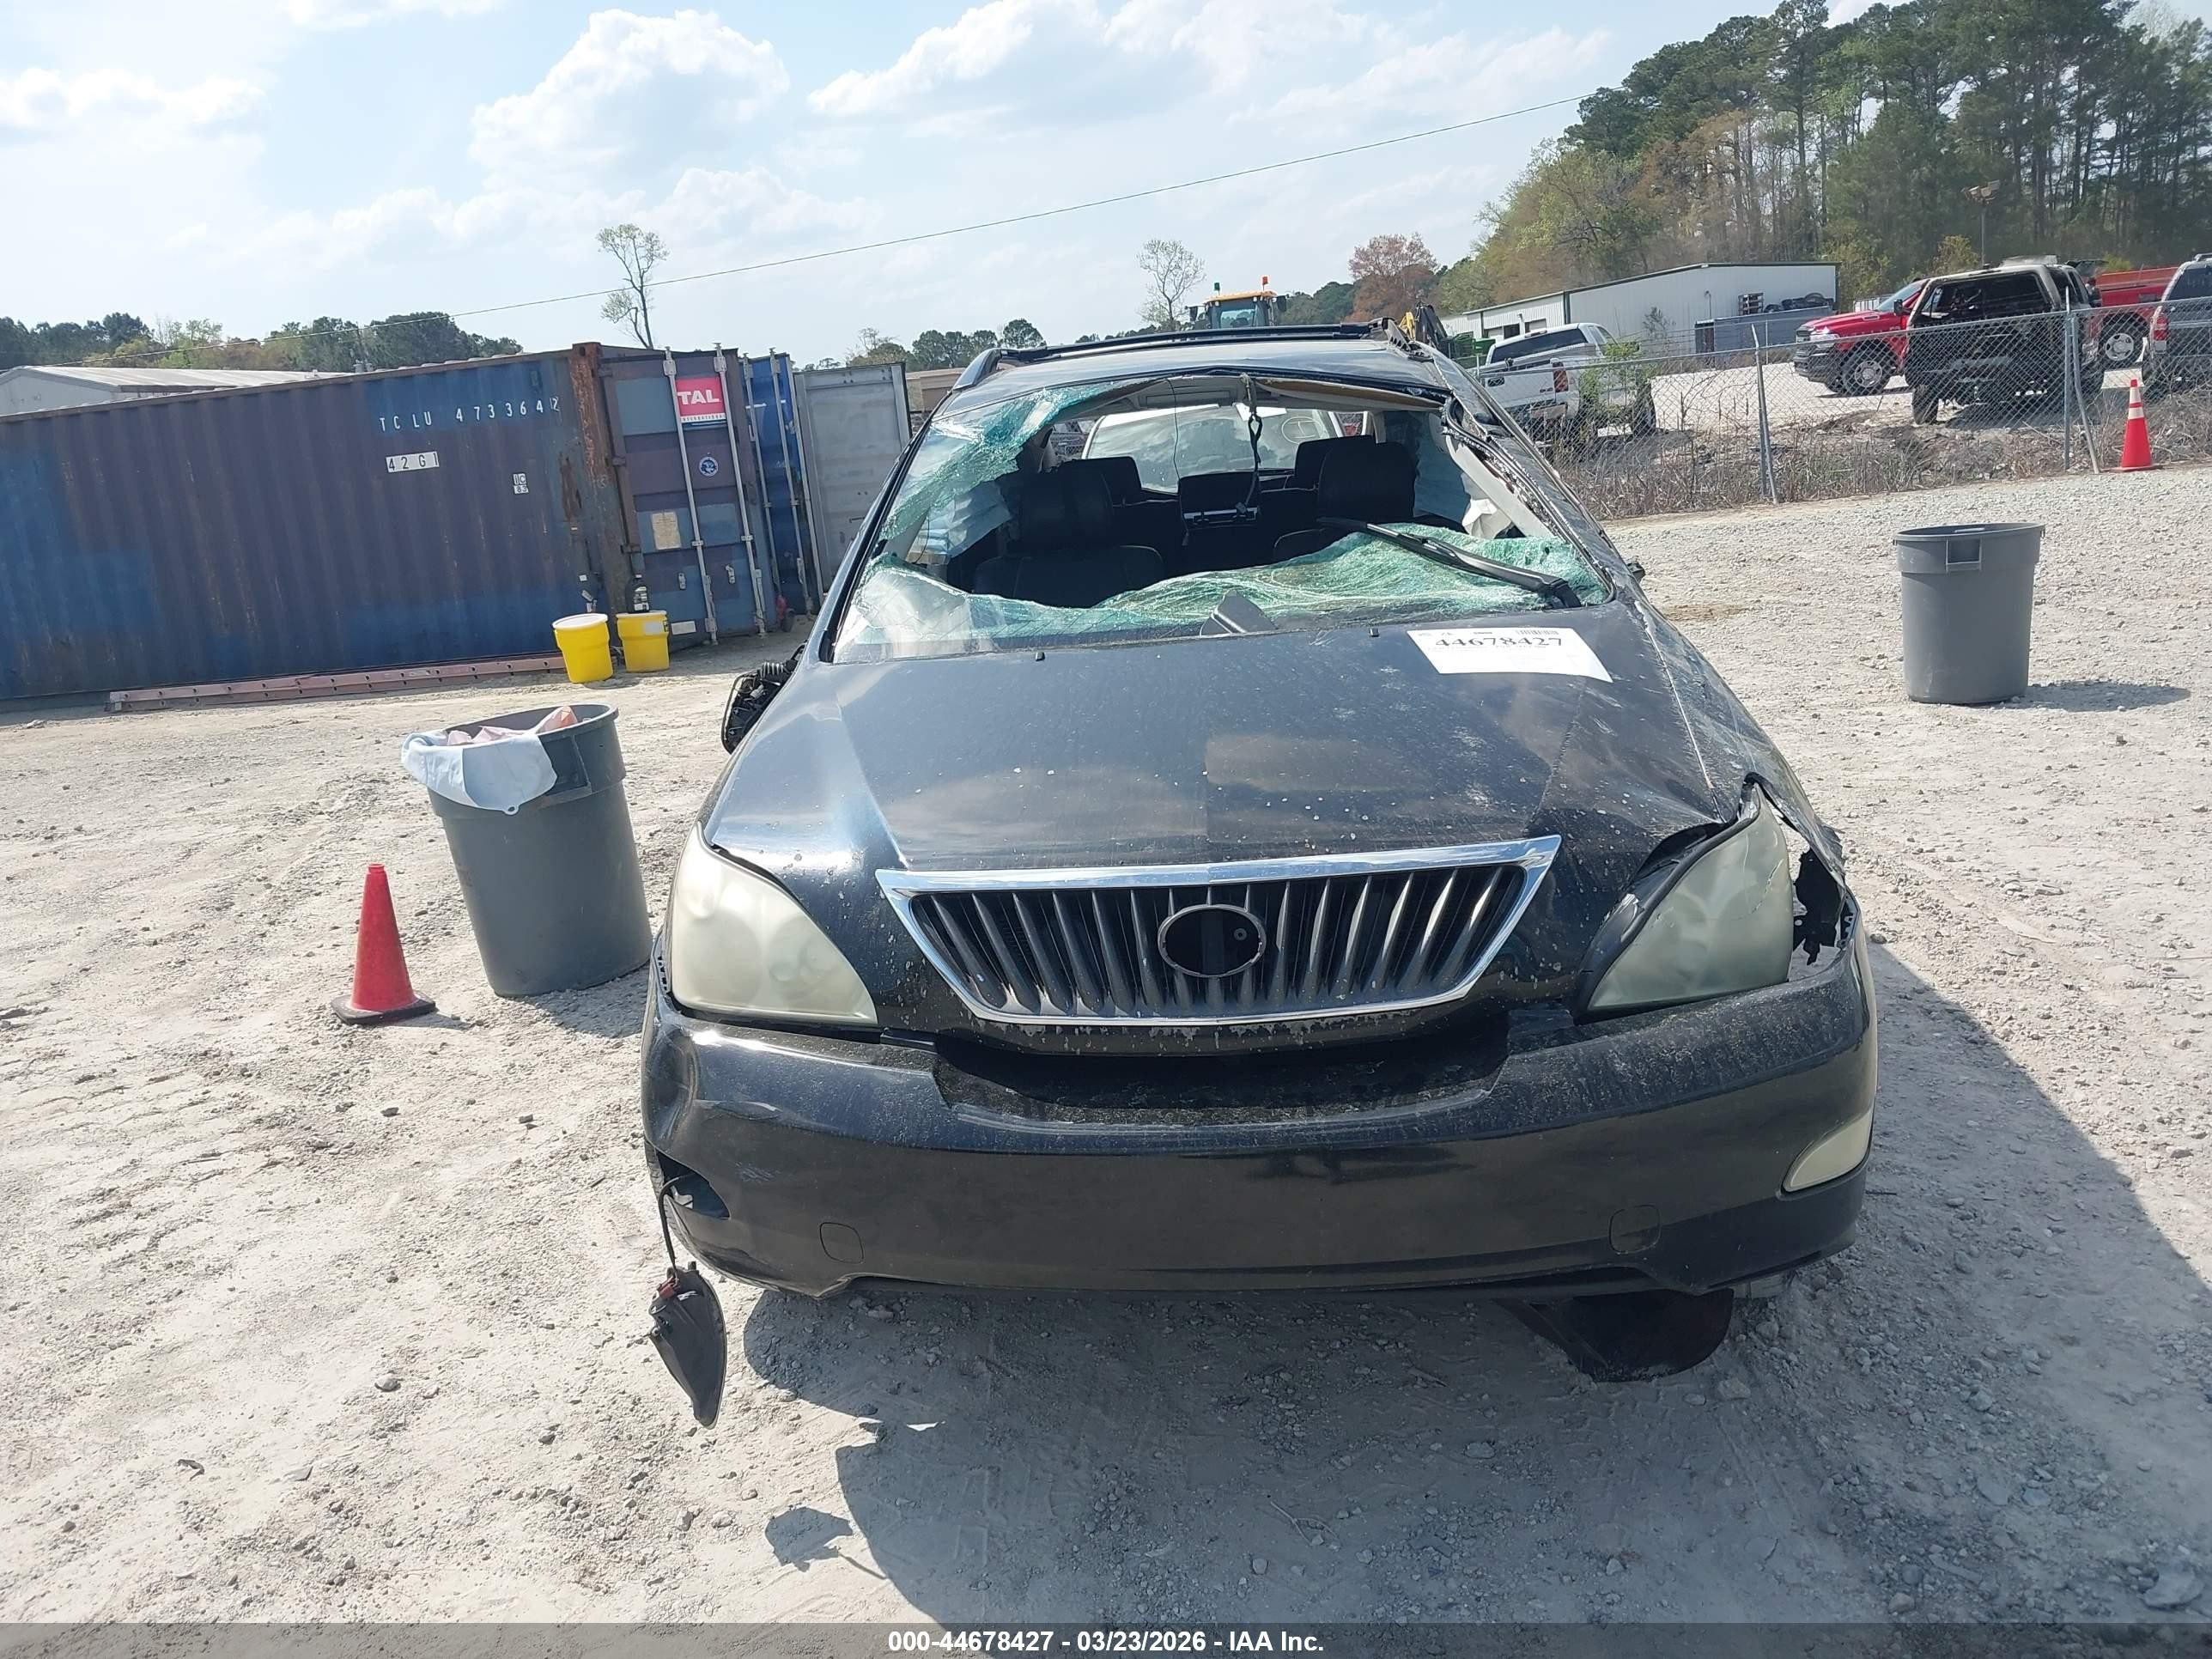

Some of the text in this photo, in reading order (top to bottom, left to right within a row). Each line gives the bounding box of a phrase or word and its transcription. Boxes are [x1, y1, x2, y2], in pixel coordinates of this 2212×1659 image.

[677, 389, 720, 405] TAL
[379, 411, 433, 432] TCLU
[388, 451, 439, 471] 42G1
[1435, 637, 1562, 647] 44678427
